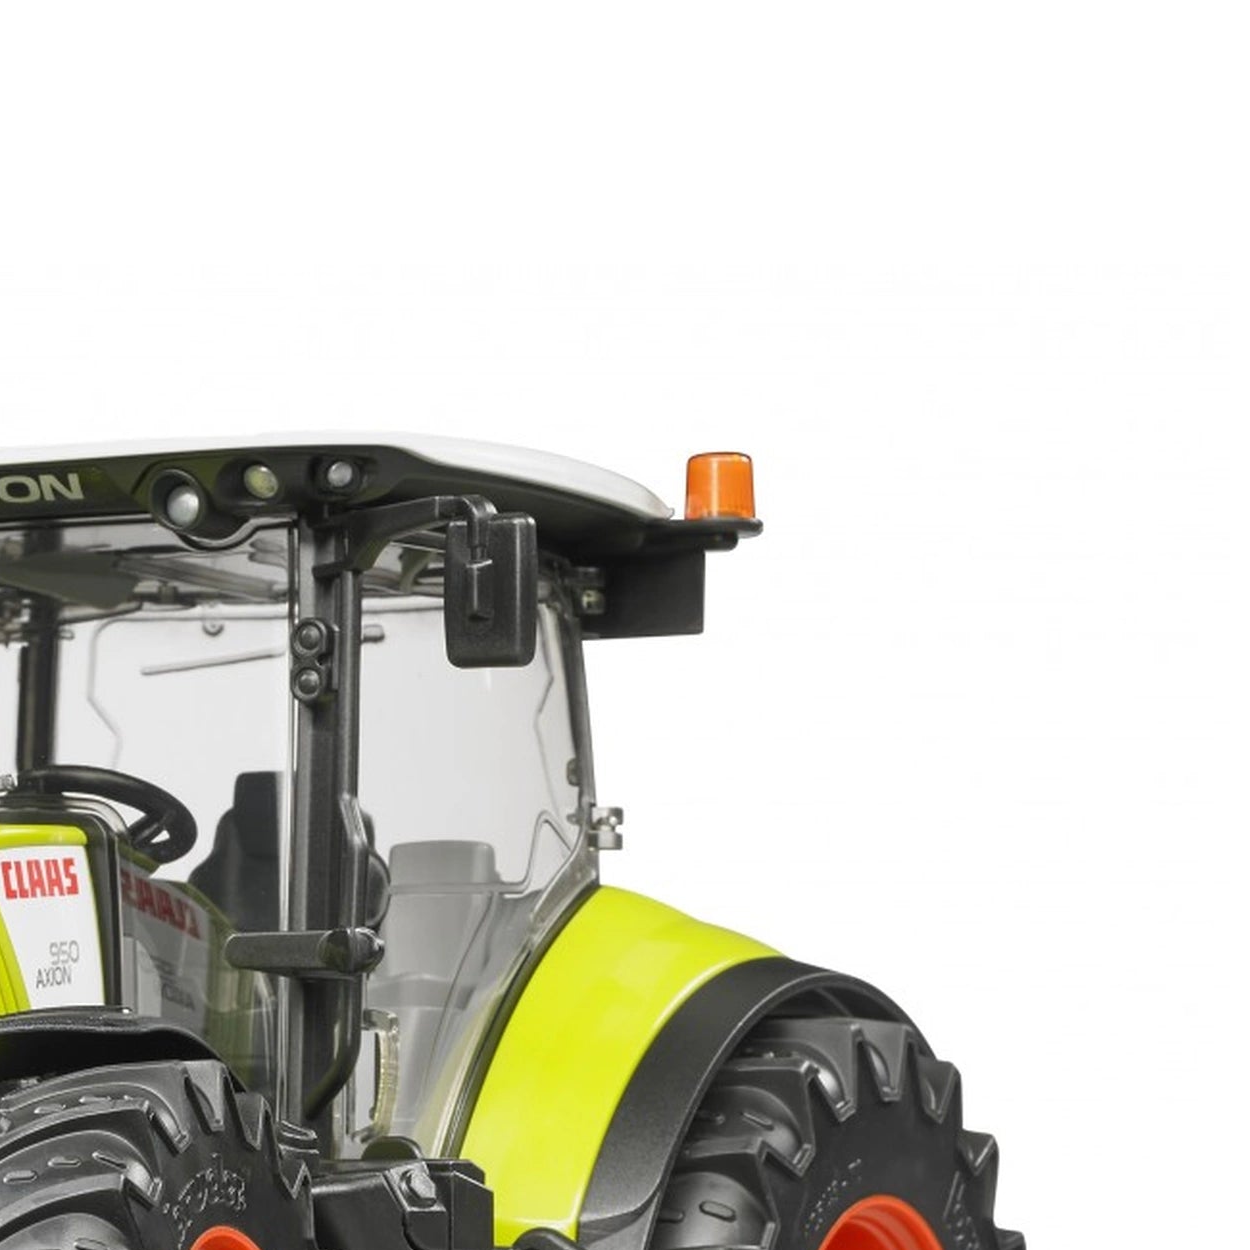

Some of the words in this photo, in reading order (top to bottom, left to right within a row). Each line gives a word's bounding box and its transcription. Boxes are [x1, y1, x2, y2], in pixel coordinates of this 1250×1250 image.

[1, 858, 79, 900] CLAAS
[49, 940, 79, 965] 950
[36, 966, 72, 989] AXION
